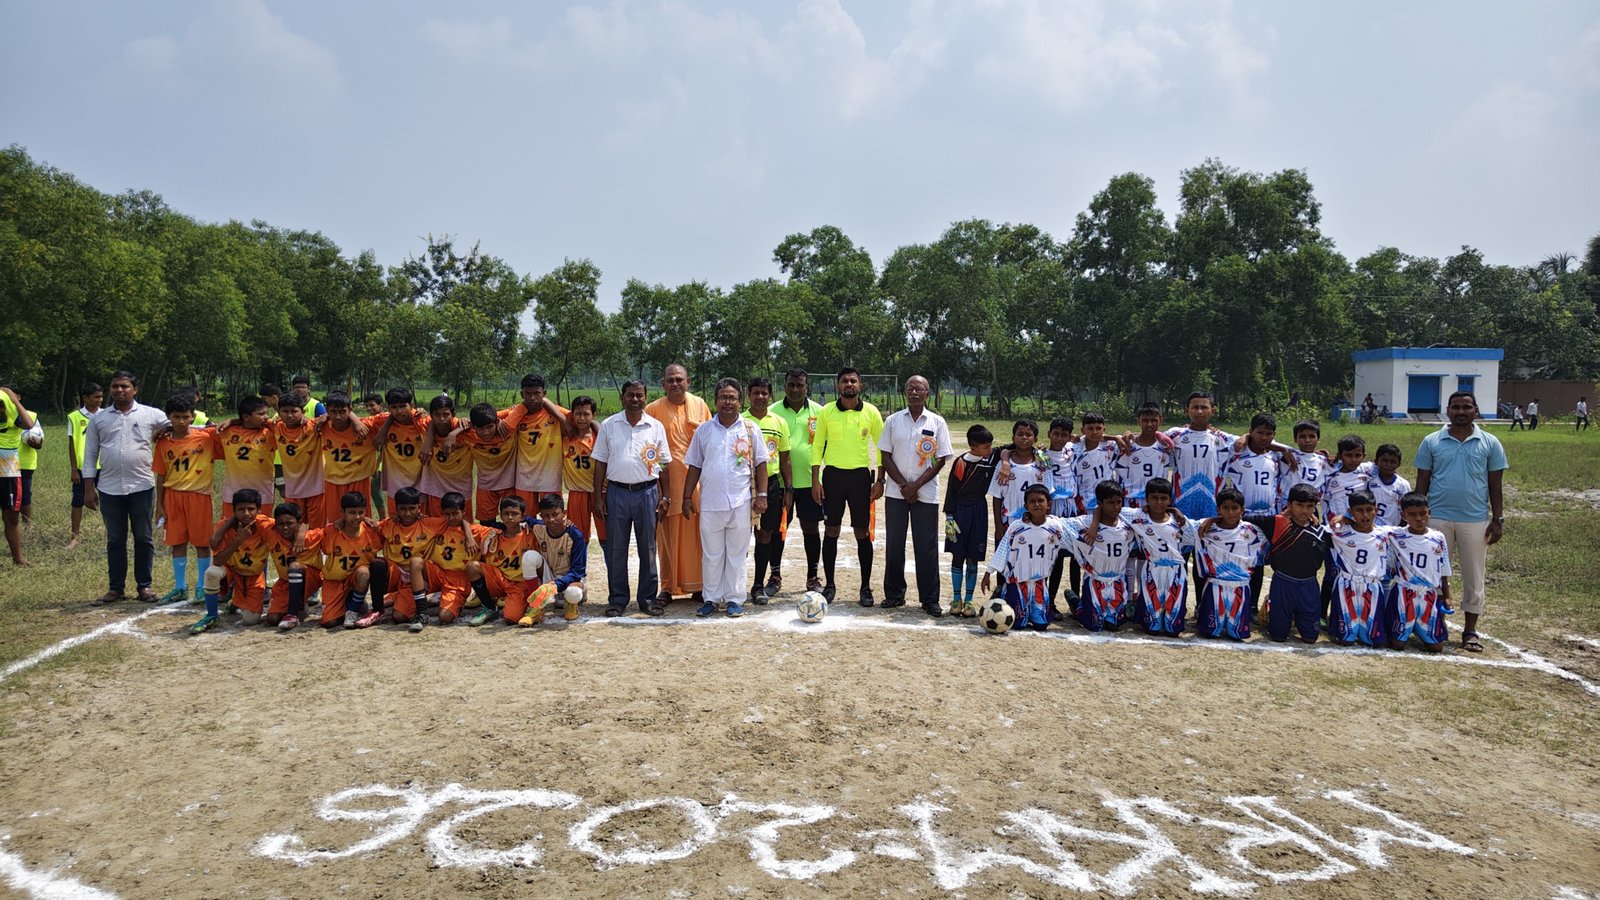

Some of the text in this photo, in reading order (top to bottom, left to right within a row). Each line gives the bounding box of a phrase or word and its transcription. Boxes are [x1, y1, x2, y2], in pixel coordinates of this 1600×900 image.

[528, 431, 540, 445] 7
[238, 446, 250, 460] 2
[331, 448, 352, 462] 12
[394, 443, 415, 457] 10
[1192, 444, 1209, 458] 17
[173, 457, 190, 472] 11
[573, 455, 591, 469] 15
[1052, 464, 1062, 476] 2
[1093, 464, 1104, 479] 11
[1143, 463, 1153, 477] 9
[1301, 466, 1317, 482] 15
[1254, 470, 1270, 486] 12
[1020, 480, 1030, 491] 4
[401, 545, 412, 559] 6
[1028, 543, 1045, 559] 14
[1106, 542, 1122, 557] 16
[1157, 538, 1169, 553] 3
[1225, 542, 1236, 553] 7
[240, 553, 253, 567] 4
[443, 546, 454, 561] 3
[1355, 549, 1368, 565] 8
[1409, 552, 1428, 569] 10
[339, 556, 361, 570] 17
[501, 556, 520, 570] 14
